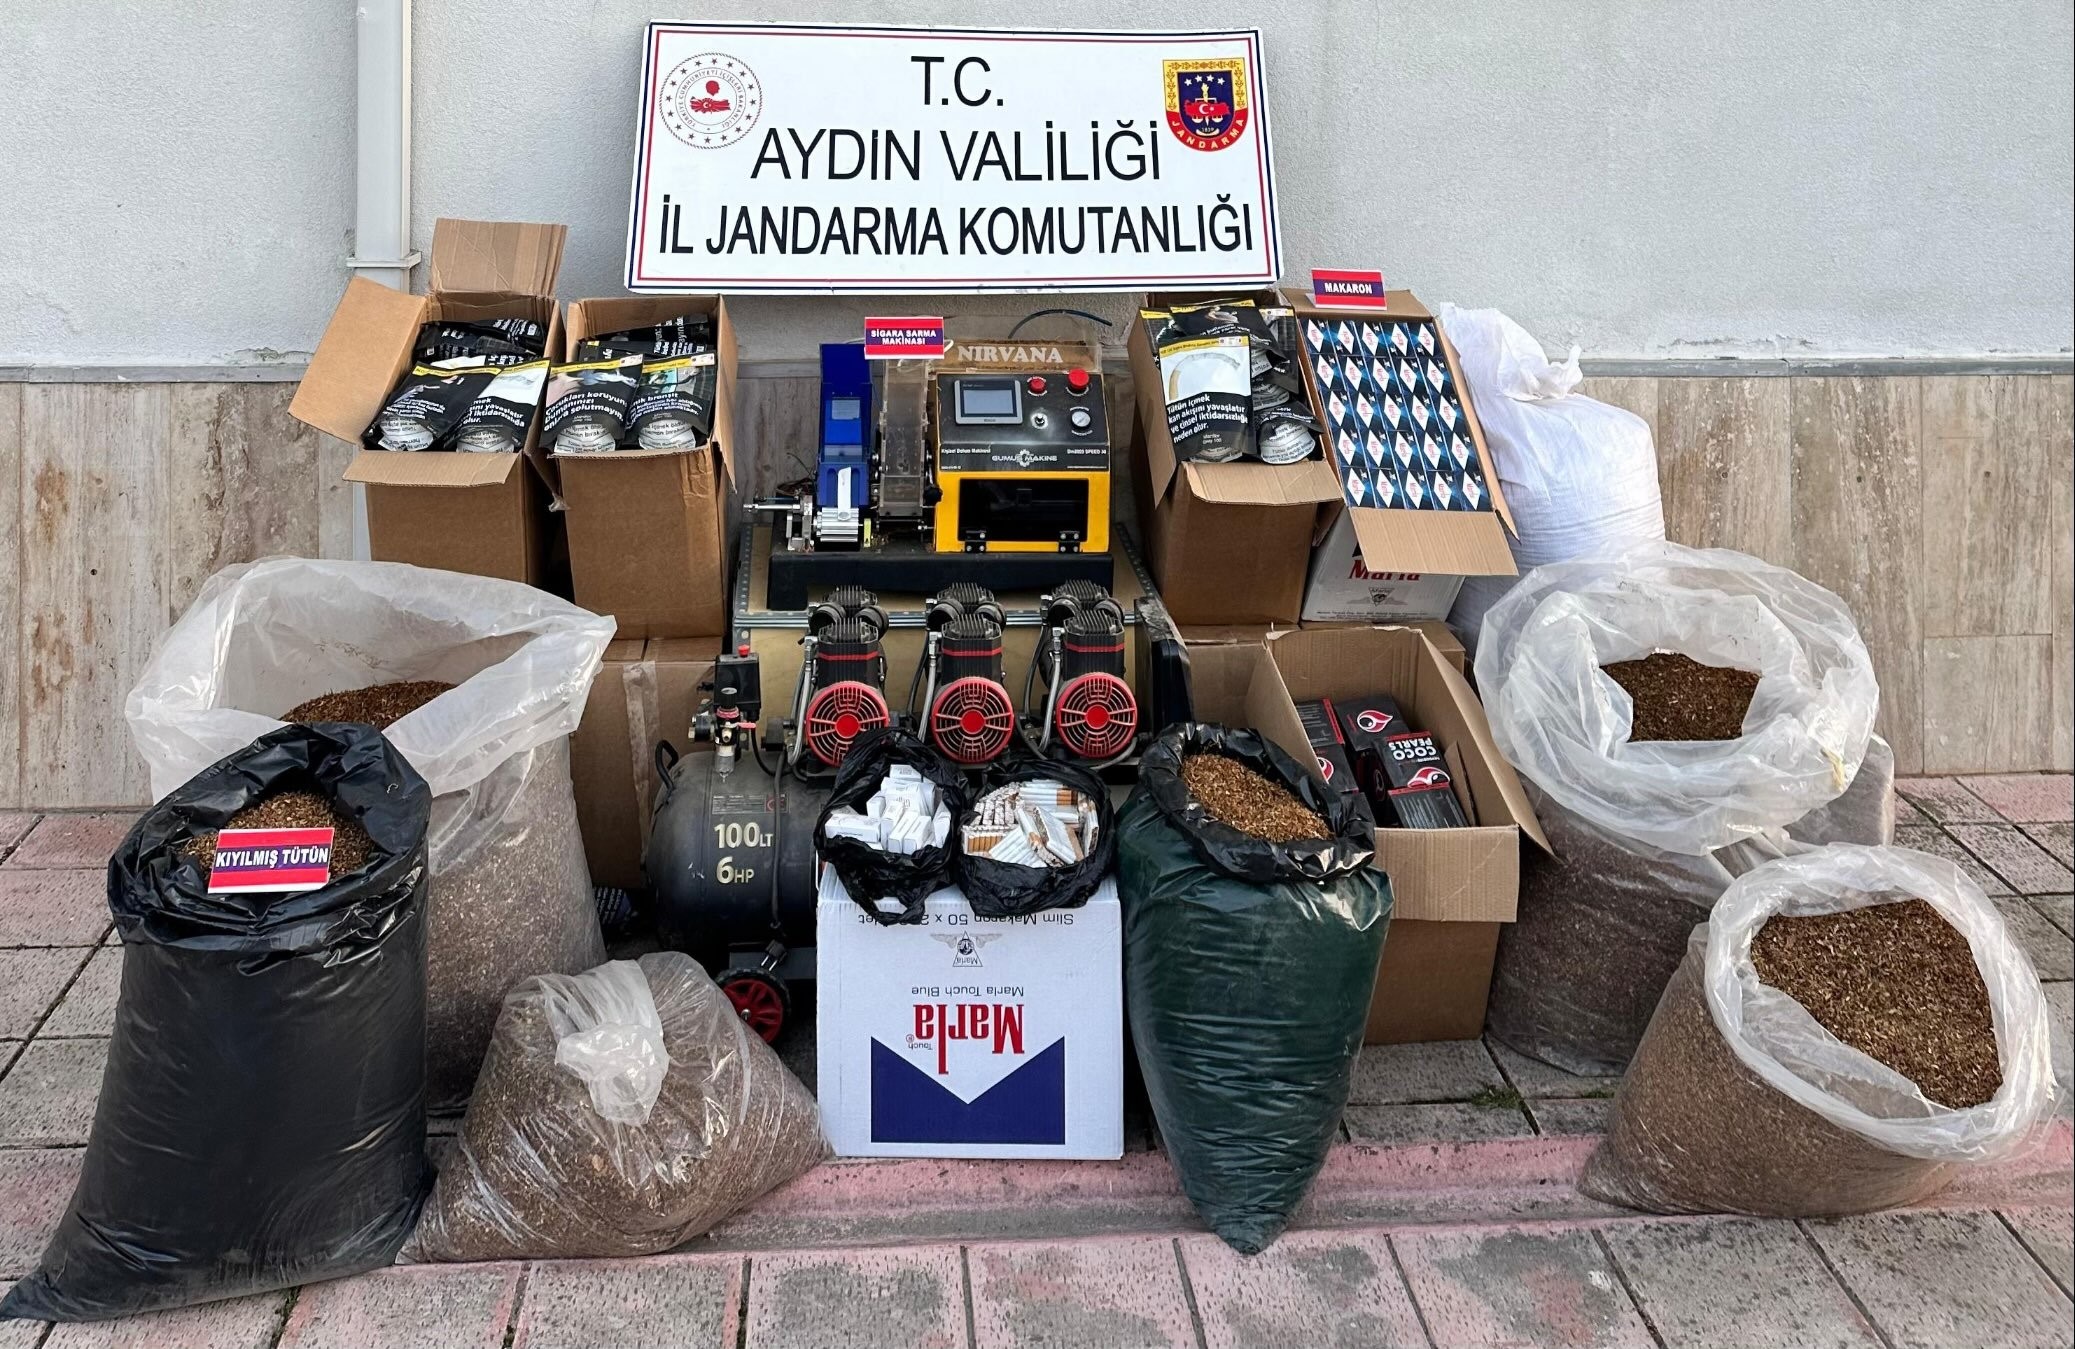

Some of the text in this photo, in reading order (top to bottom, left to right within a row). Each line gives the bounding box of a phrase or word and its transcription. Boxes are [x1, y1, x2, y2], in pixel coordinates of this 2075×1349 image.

[910, 55, 1004, 107] T.C.
[1171, 119, 1244, 149] JANDARMA
[750, 119, 1161, 182] AYDIN VALİLİĞİ
[659, 193, 1253, 256] İL JANDARMA KOMUTANLIĞI
[1324, 282, 1373, 294] MAKARON
[871, 328, 937, 337] SİGARA SARMA
[882, 336, 926, 345] MAKİNASI
[957, 345, 1064, 363] NIRVANA
[1167, 401, 1187, 415] Tütün
[1168, 413, 1181, 424] kan
[1206, 403, 1245, 413] yavaşlatır
[1173, 428, 1193, 444] neden
[1388, 737, 1433, 750] PEARLS
[1393, 745, 1437, 761] COCO
[215, 845, 329, 869] KIYILMIŞ TÜTÜN
[935, 914, 942, 922] x
[948, 914, 968, 925] 50
[1043, 913, 1074, 925] Slim
[956, 957, 978, 965] Marla
[911, 985, 1024, 997] Marla Touch Blue
[908, 1042, 933, 1051] Touch
[913, 1004, 1025, 1075] Marla
